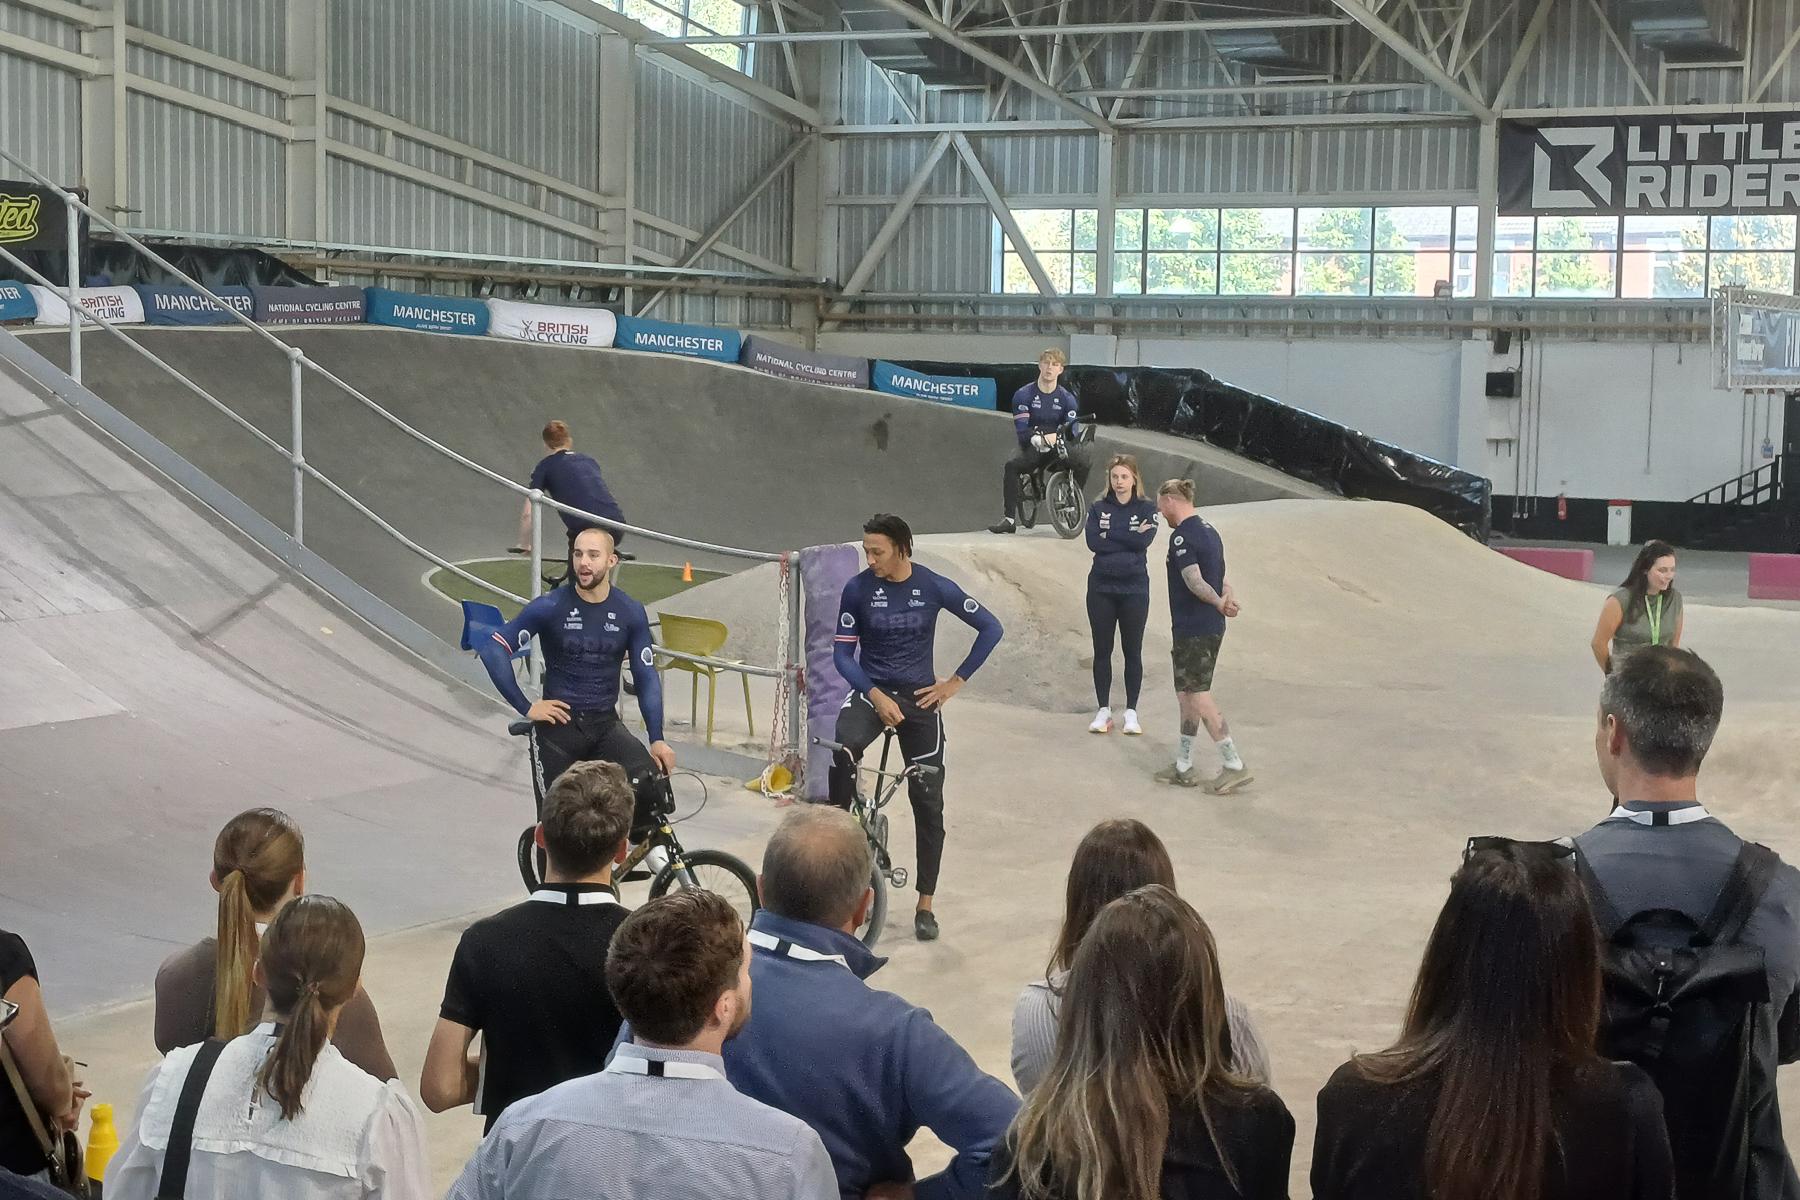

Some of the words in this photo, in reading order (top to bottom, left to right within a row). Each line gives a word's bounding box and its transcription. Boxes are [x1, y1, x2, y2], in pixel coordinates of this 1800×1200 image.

[1627, 121, 1800, 161] LITTLE
[1625, 163, 1800, 208] RIDER
[0, 287, 21, 300] TER
[80, 295, 124, 308] BRITISH
[268, 303, 304, 312] NATIONAL
[305, 302, 334, 312] CYCLING
[335, 300, 361, 310] CENTRE
[393, 304, 476, 326] MANCHESTER
[537, 321, 589, 335] BRITISH
[536, 332, 588, 345] CYCLING
[634, 332, 724, 352] MANCHESTER
[756, 352, 794, 370] NATIONAL
[795, 362, 827, 376] CYCLING
[828, 369, 857, 380] CENTRE
[891, 374, 979, 396] MANCHESTER
